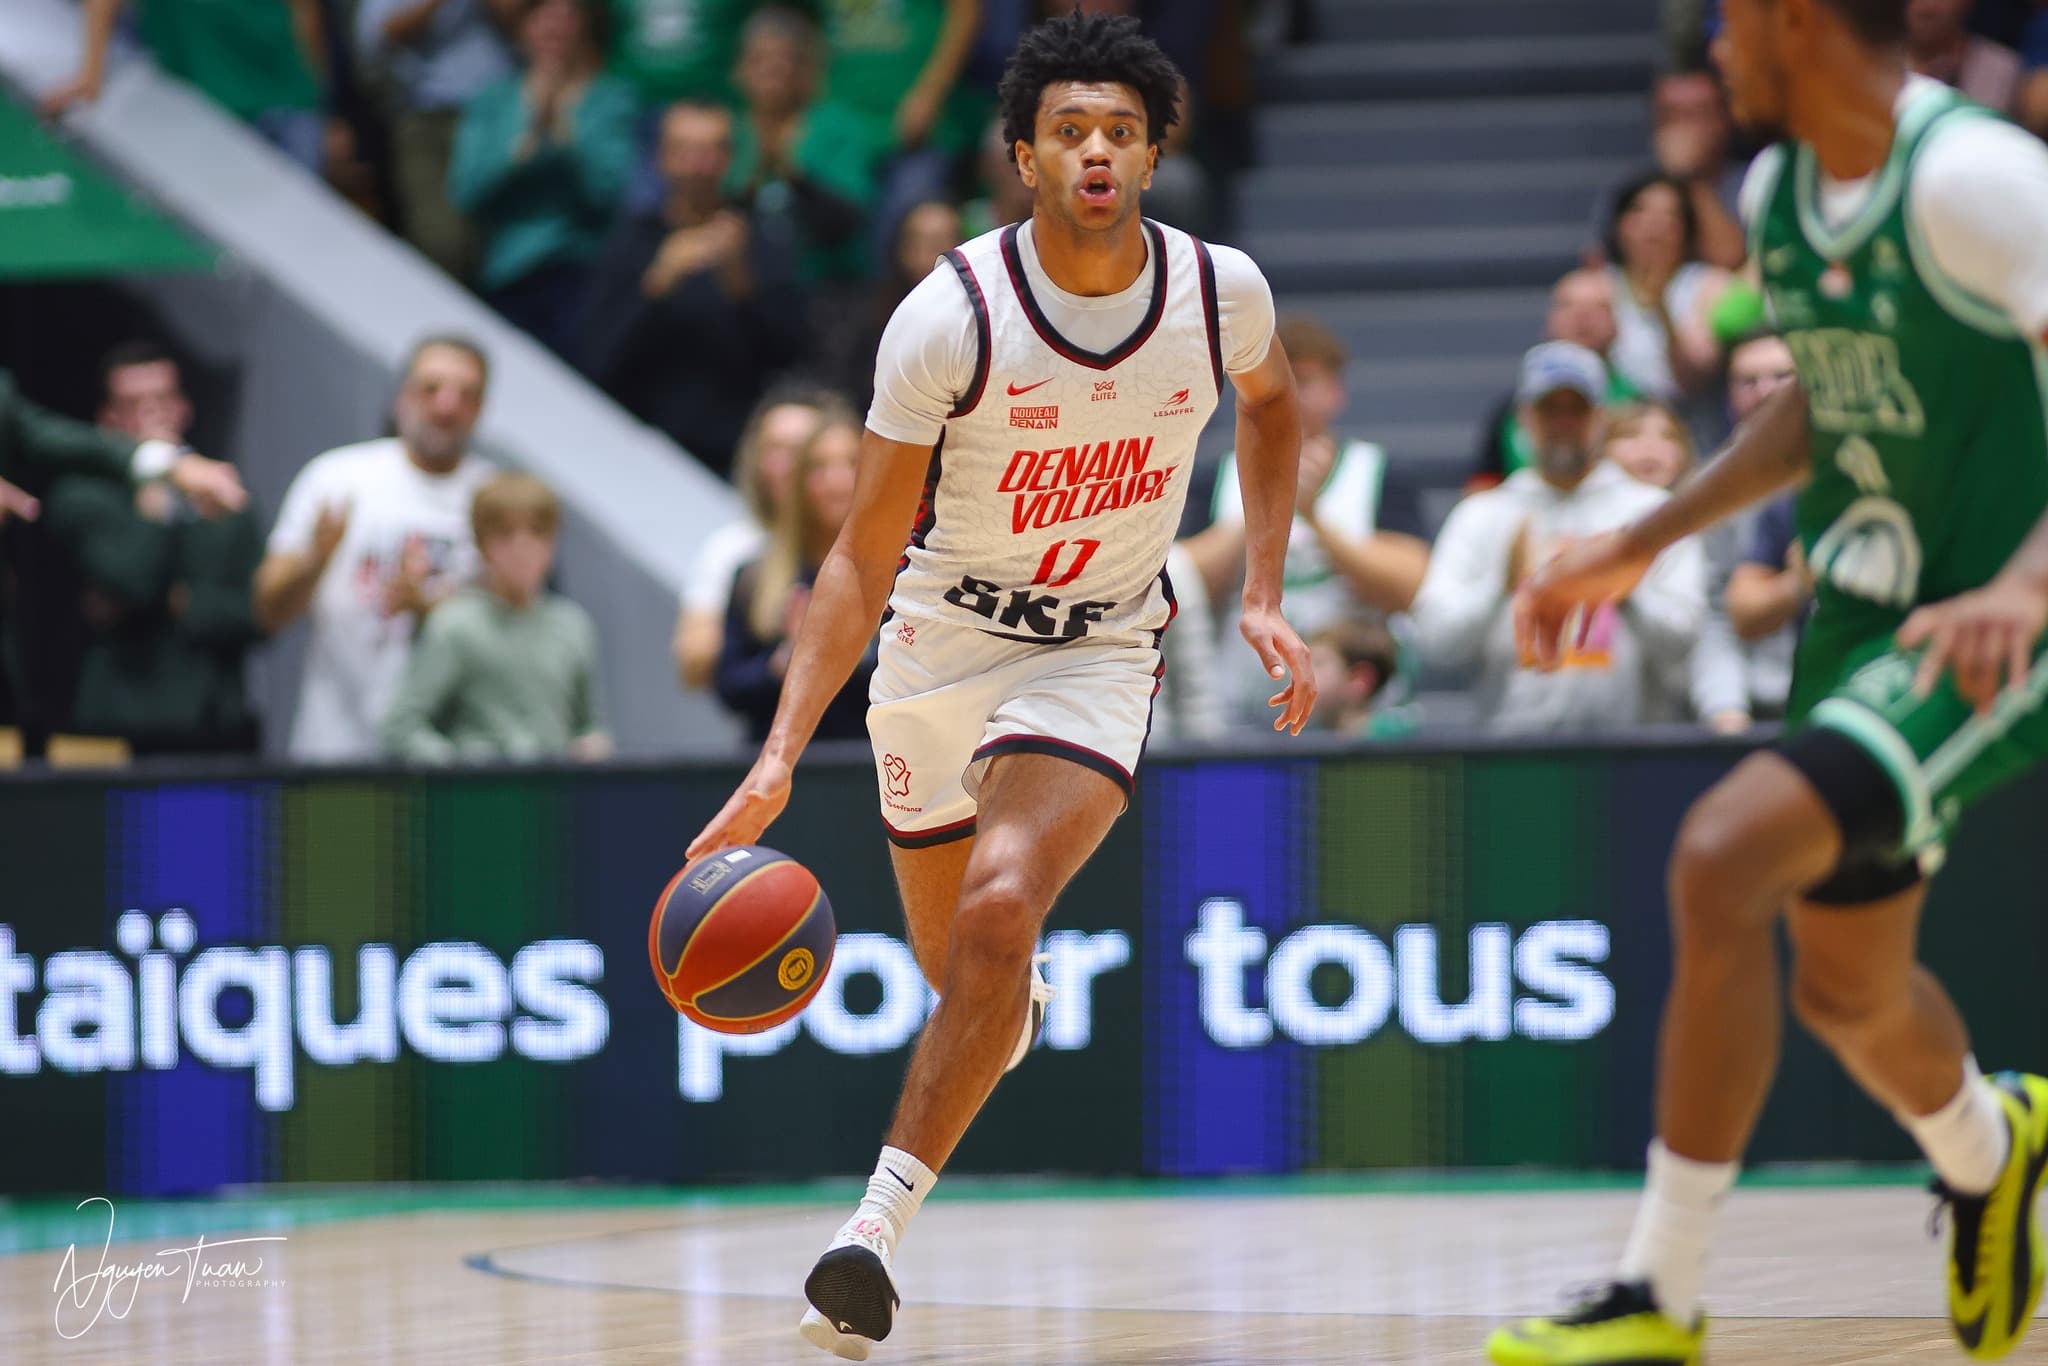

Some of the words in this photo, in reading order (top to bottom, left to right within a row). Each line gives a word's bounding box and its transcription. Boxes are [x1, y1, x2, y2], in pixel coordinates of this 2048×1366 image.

[1009, 418, 1058, 429] DENAIN
[1012, 406, 1057, 419] NOUVEAU
[1153, 406, 1194, 417] LESAFFRE
[997, 436, 1154, 492] DENAIN
[1011, 464, 1179, 535] VOLTAIRE
[1030, 538, 1101, 588] 17
[943, 574, 1119, 637] SKF
[1183, 896, 1616, 1048] tous
